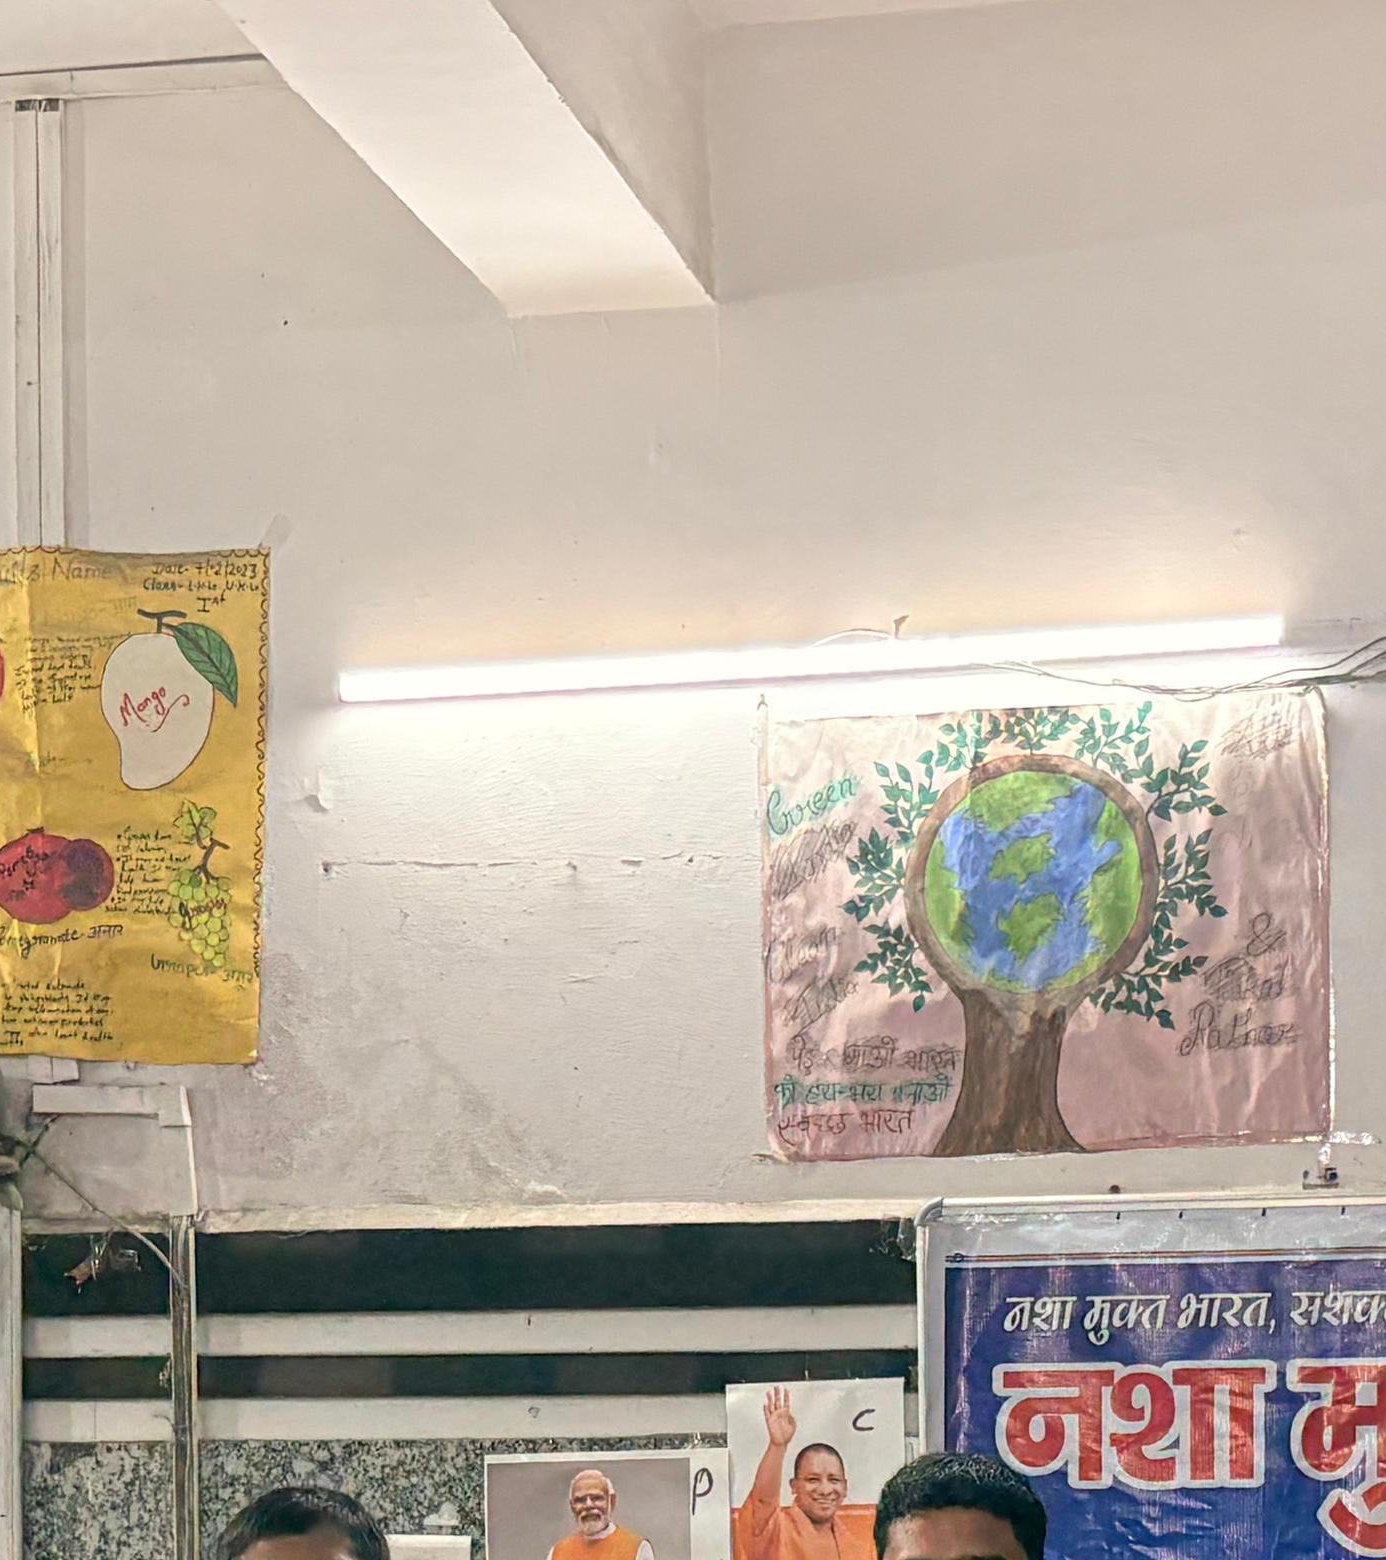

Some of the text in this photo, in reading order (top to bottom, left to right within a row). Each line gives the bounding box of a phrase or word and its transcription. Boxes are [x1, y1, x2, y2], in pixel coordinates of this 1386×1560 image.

[119, 686, 177, 733] Mango
[860, 1108, 915, 1135] भारत
[1002, 1294, 1077, 1333] नशा
[1083, 1292, 1171, 1346] मुक्त
[1176, 1291, 1277, 1336] भारत,
[851, 1407, 876, 1433] C
[991, 1358, 1278, 1492] नशा
[691, 1466, 714, 1515] P
